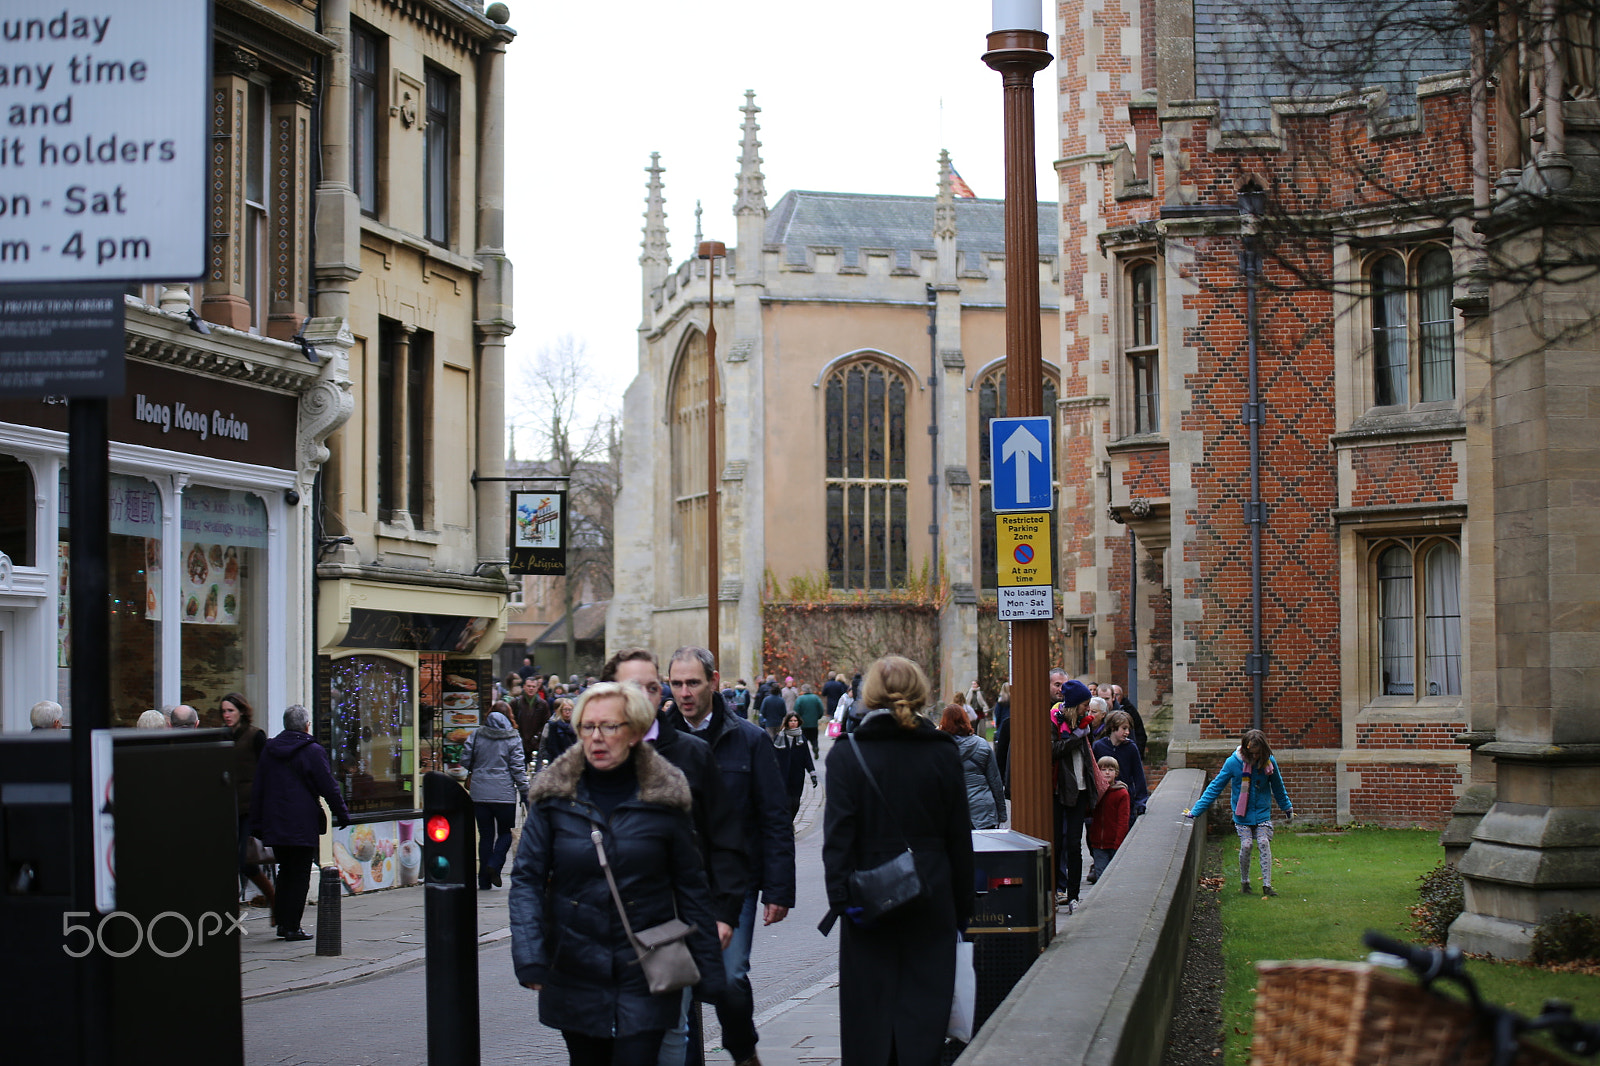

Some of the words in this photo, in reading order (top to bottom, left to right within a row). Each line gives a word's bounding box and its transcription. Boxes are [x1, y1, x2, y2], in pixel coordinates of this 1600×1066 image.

[69, 55, 148, 83] time
[8, 96, 73, 126] and
[40, 134, 176, 165] holders
[64, 186, 127, 215] Sat
[62, 231, 85, 261] 4
[98, 237, 151, 265] pm
[136, 393, 171, 433] Hong
[174, 402, 208, 441] Kong
[1002, 516, 1044, 525] Restricted
[1008, 525, 1038, 533] Parking
[1013, 533, 1033, 541] Zone
[510, 552, 525, 569] Le
[1011, 567, 1021, 575] At
[1017, 589, 1047, 597] loading
[1006, 600, 1024, 608] Mon
[1030, 599, 1045, 607] Sat
[1001, 609, 1011, 617] 10
[1030, 608, 1036, 616] 4
